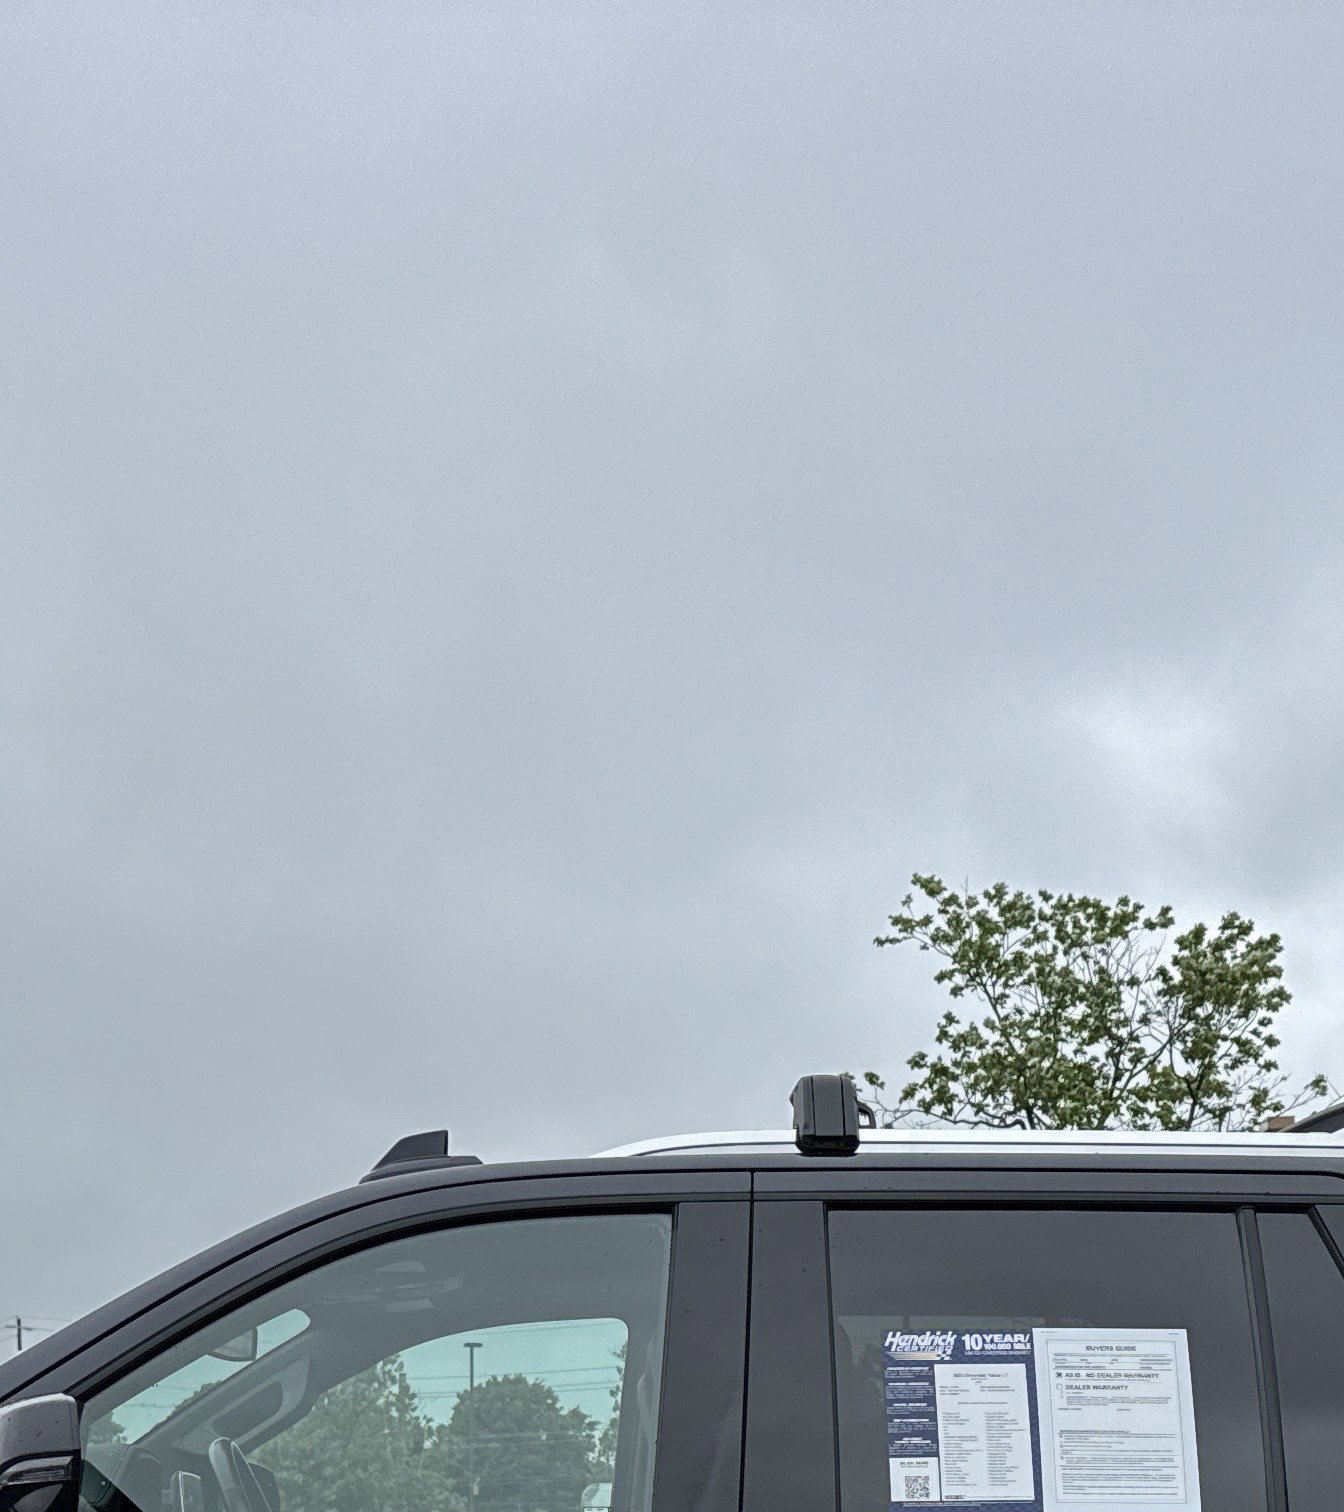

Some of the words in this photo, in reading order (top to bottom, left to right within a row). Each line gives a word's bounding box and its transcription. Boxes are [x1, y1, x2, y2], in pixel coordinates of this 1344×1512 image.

[885, 1331, 957, 1352] Hendrick
[961, 1333, 983, 1351] 10
[982, 1333, 1031, 1343] YEAR/
